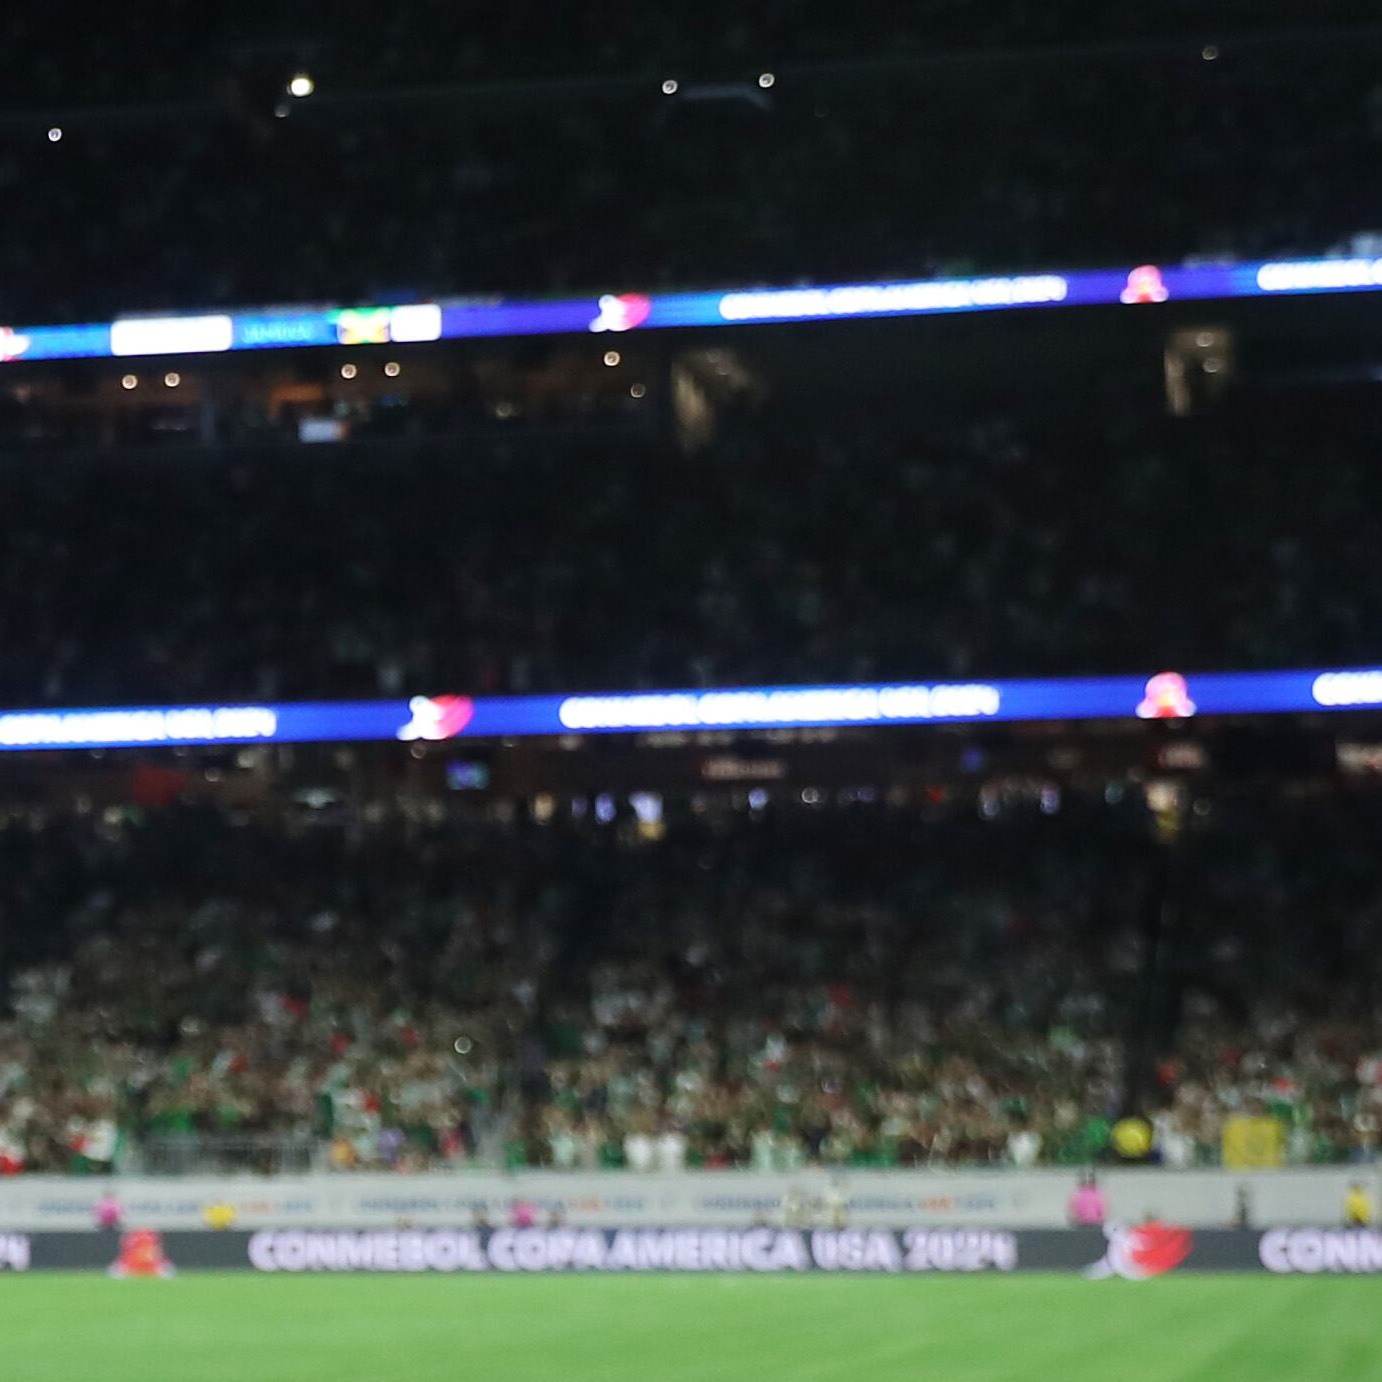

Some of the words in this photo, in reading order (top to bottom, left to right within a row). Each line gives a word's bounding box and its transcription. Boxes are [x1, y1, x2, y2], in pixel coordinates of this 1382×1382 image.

[247, 1229, 486, 1273] CONMEBOL
[487, 1229, 606, 1273] COPA
[603, 1228, 812, 1272] AMERICA
[810, 1227, 904, 1272] USA
[901, 1226, 1020, 1272] 2024
